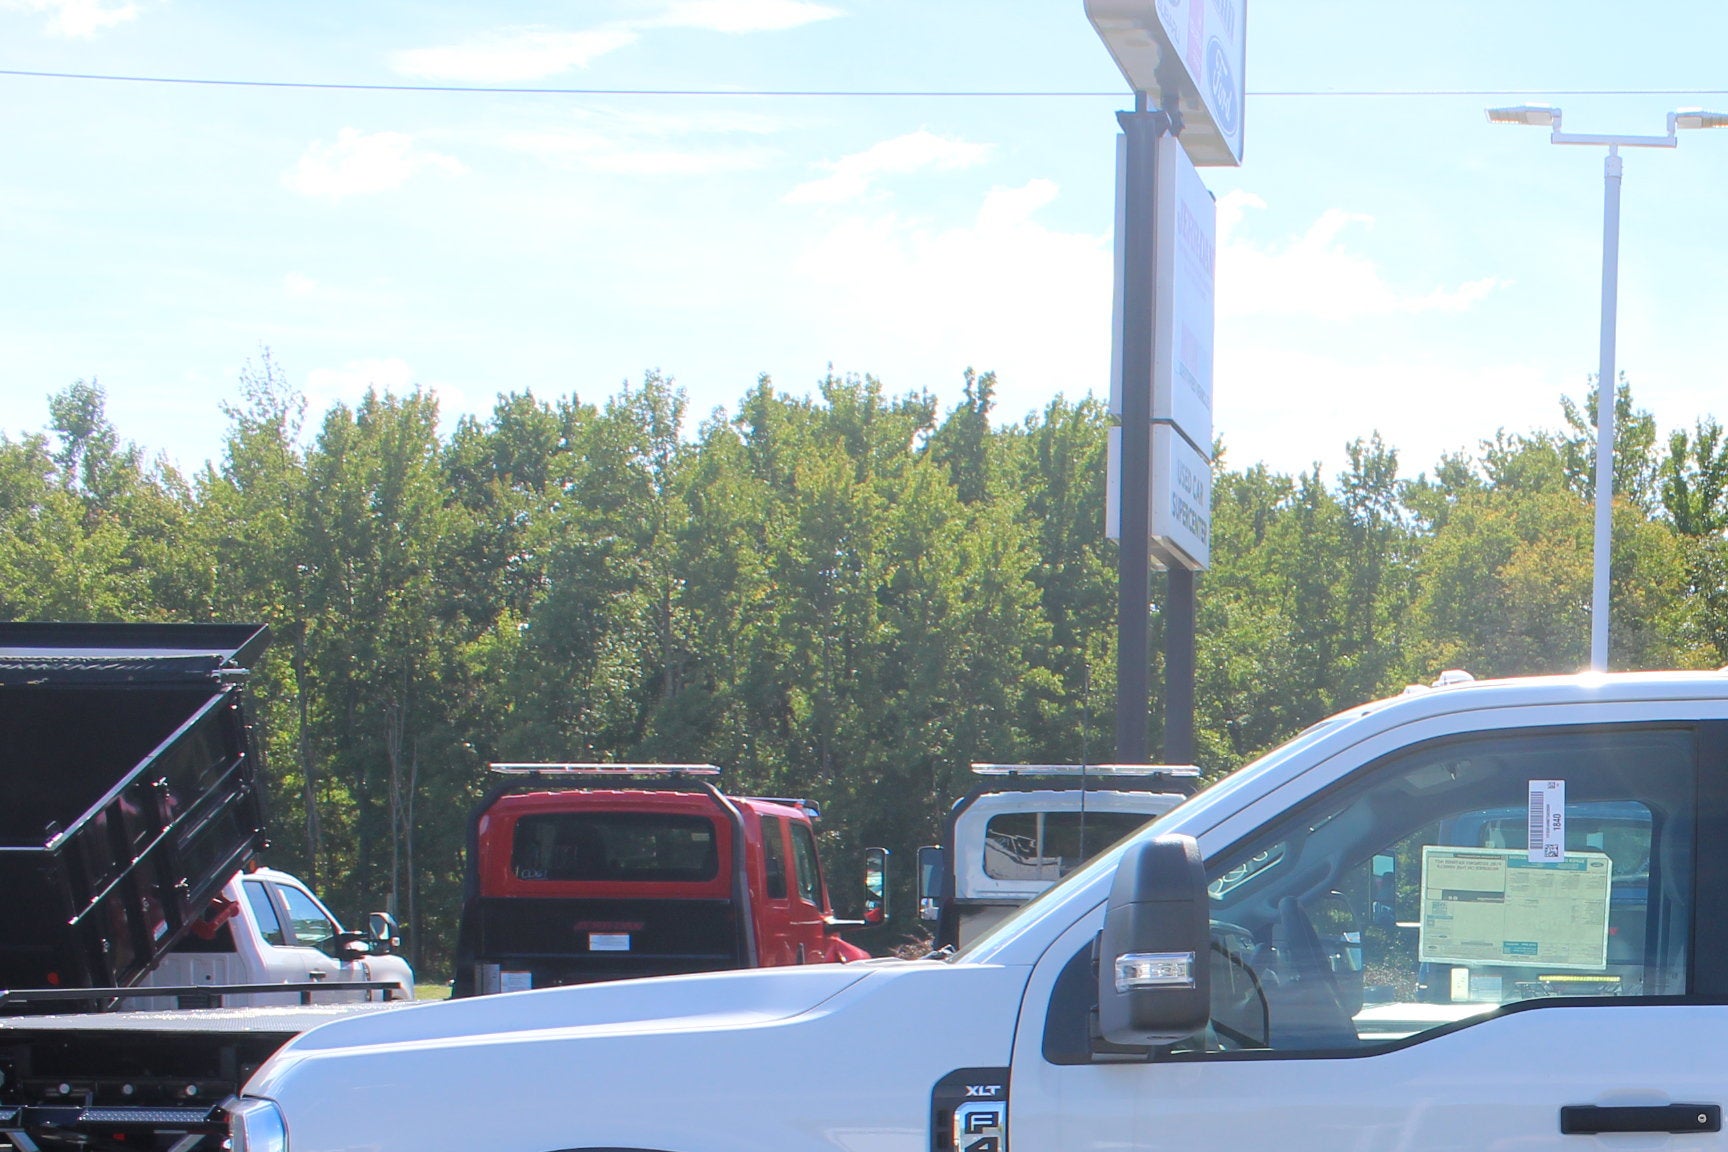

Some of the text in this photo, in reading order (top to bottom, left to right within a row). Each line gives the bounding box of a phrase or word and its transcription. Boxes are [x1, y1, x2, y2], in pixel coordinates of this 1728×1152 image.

[1212, 49, 1233, 122] Ford
[1177, 458, 1204, 507] USED CAR
[1171, 491, 1208, 546] SUPERCENTER
[1552, 813, 1562, 831] 1840
[965, 1085, 1001, 1097] XLT
